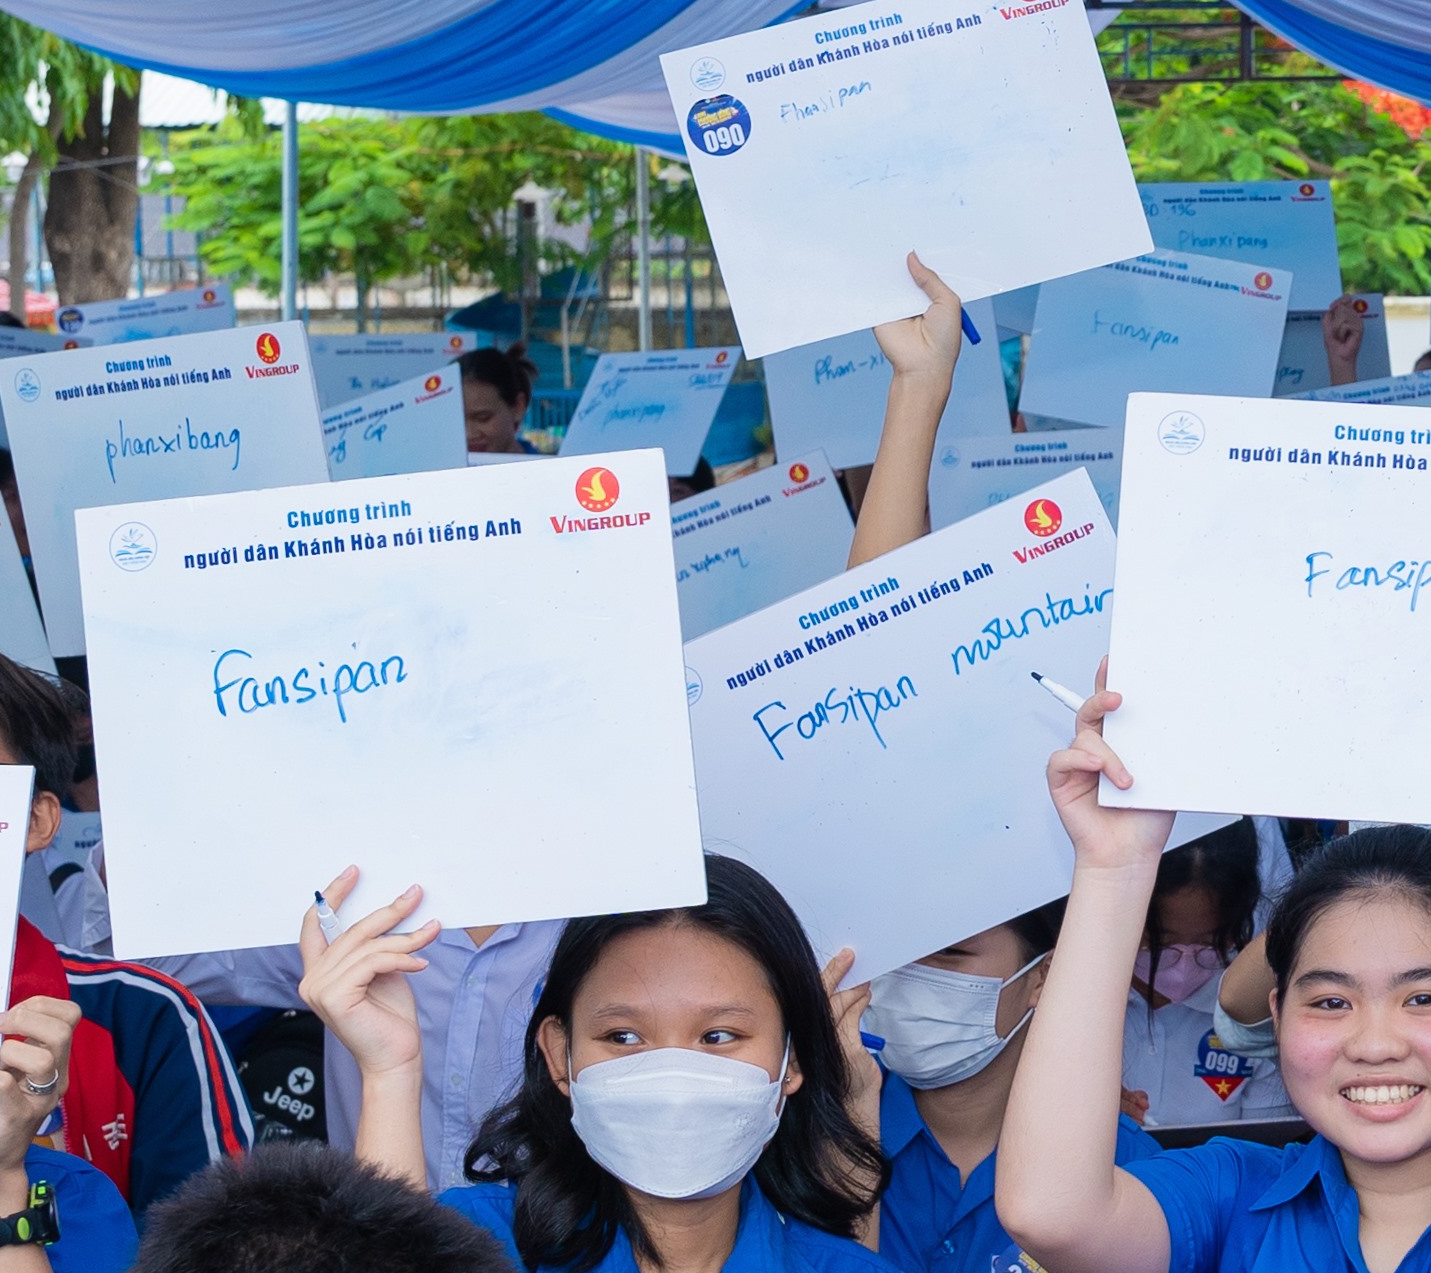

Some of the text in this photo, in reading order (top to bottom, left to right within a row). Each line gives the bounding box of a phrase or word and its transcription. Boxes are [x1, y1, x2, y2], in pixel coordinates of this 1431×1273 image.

[703, 123, 745, 153] 090
[244, 363, 299, 379] VINGROUP
[1334, 424, 1404, 445] Chương
[1228, 446, 1281, 462] người
[1287, 448, 1321, 464] dân
[1327, 449, 1386, 468] Khánh
[1391, 453, 1427, 470] Hòa
[286, 499, 411, 528] Chương trình
[549, 509, 650, 533] VINGROUP
[183, 517, 521, 569] người dân Khánh Hòa nói tiếng Anh
[1011, 522, 1094, 564] VINGROUP
[1205, 1051, 1239, 1075] 099
